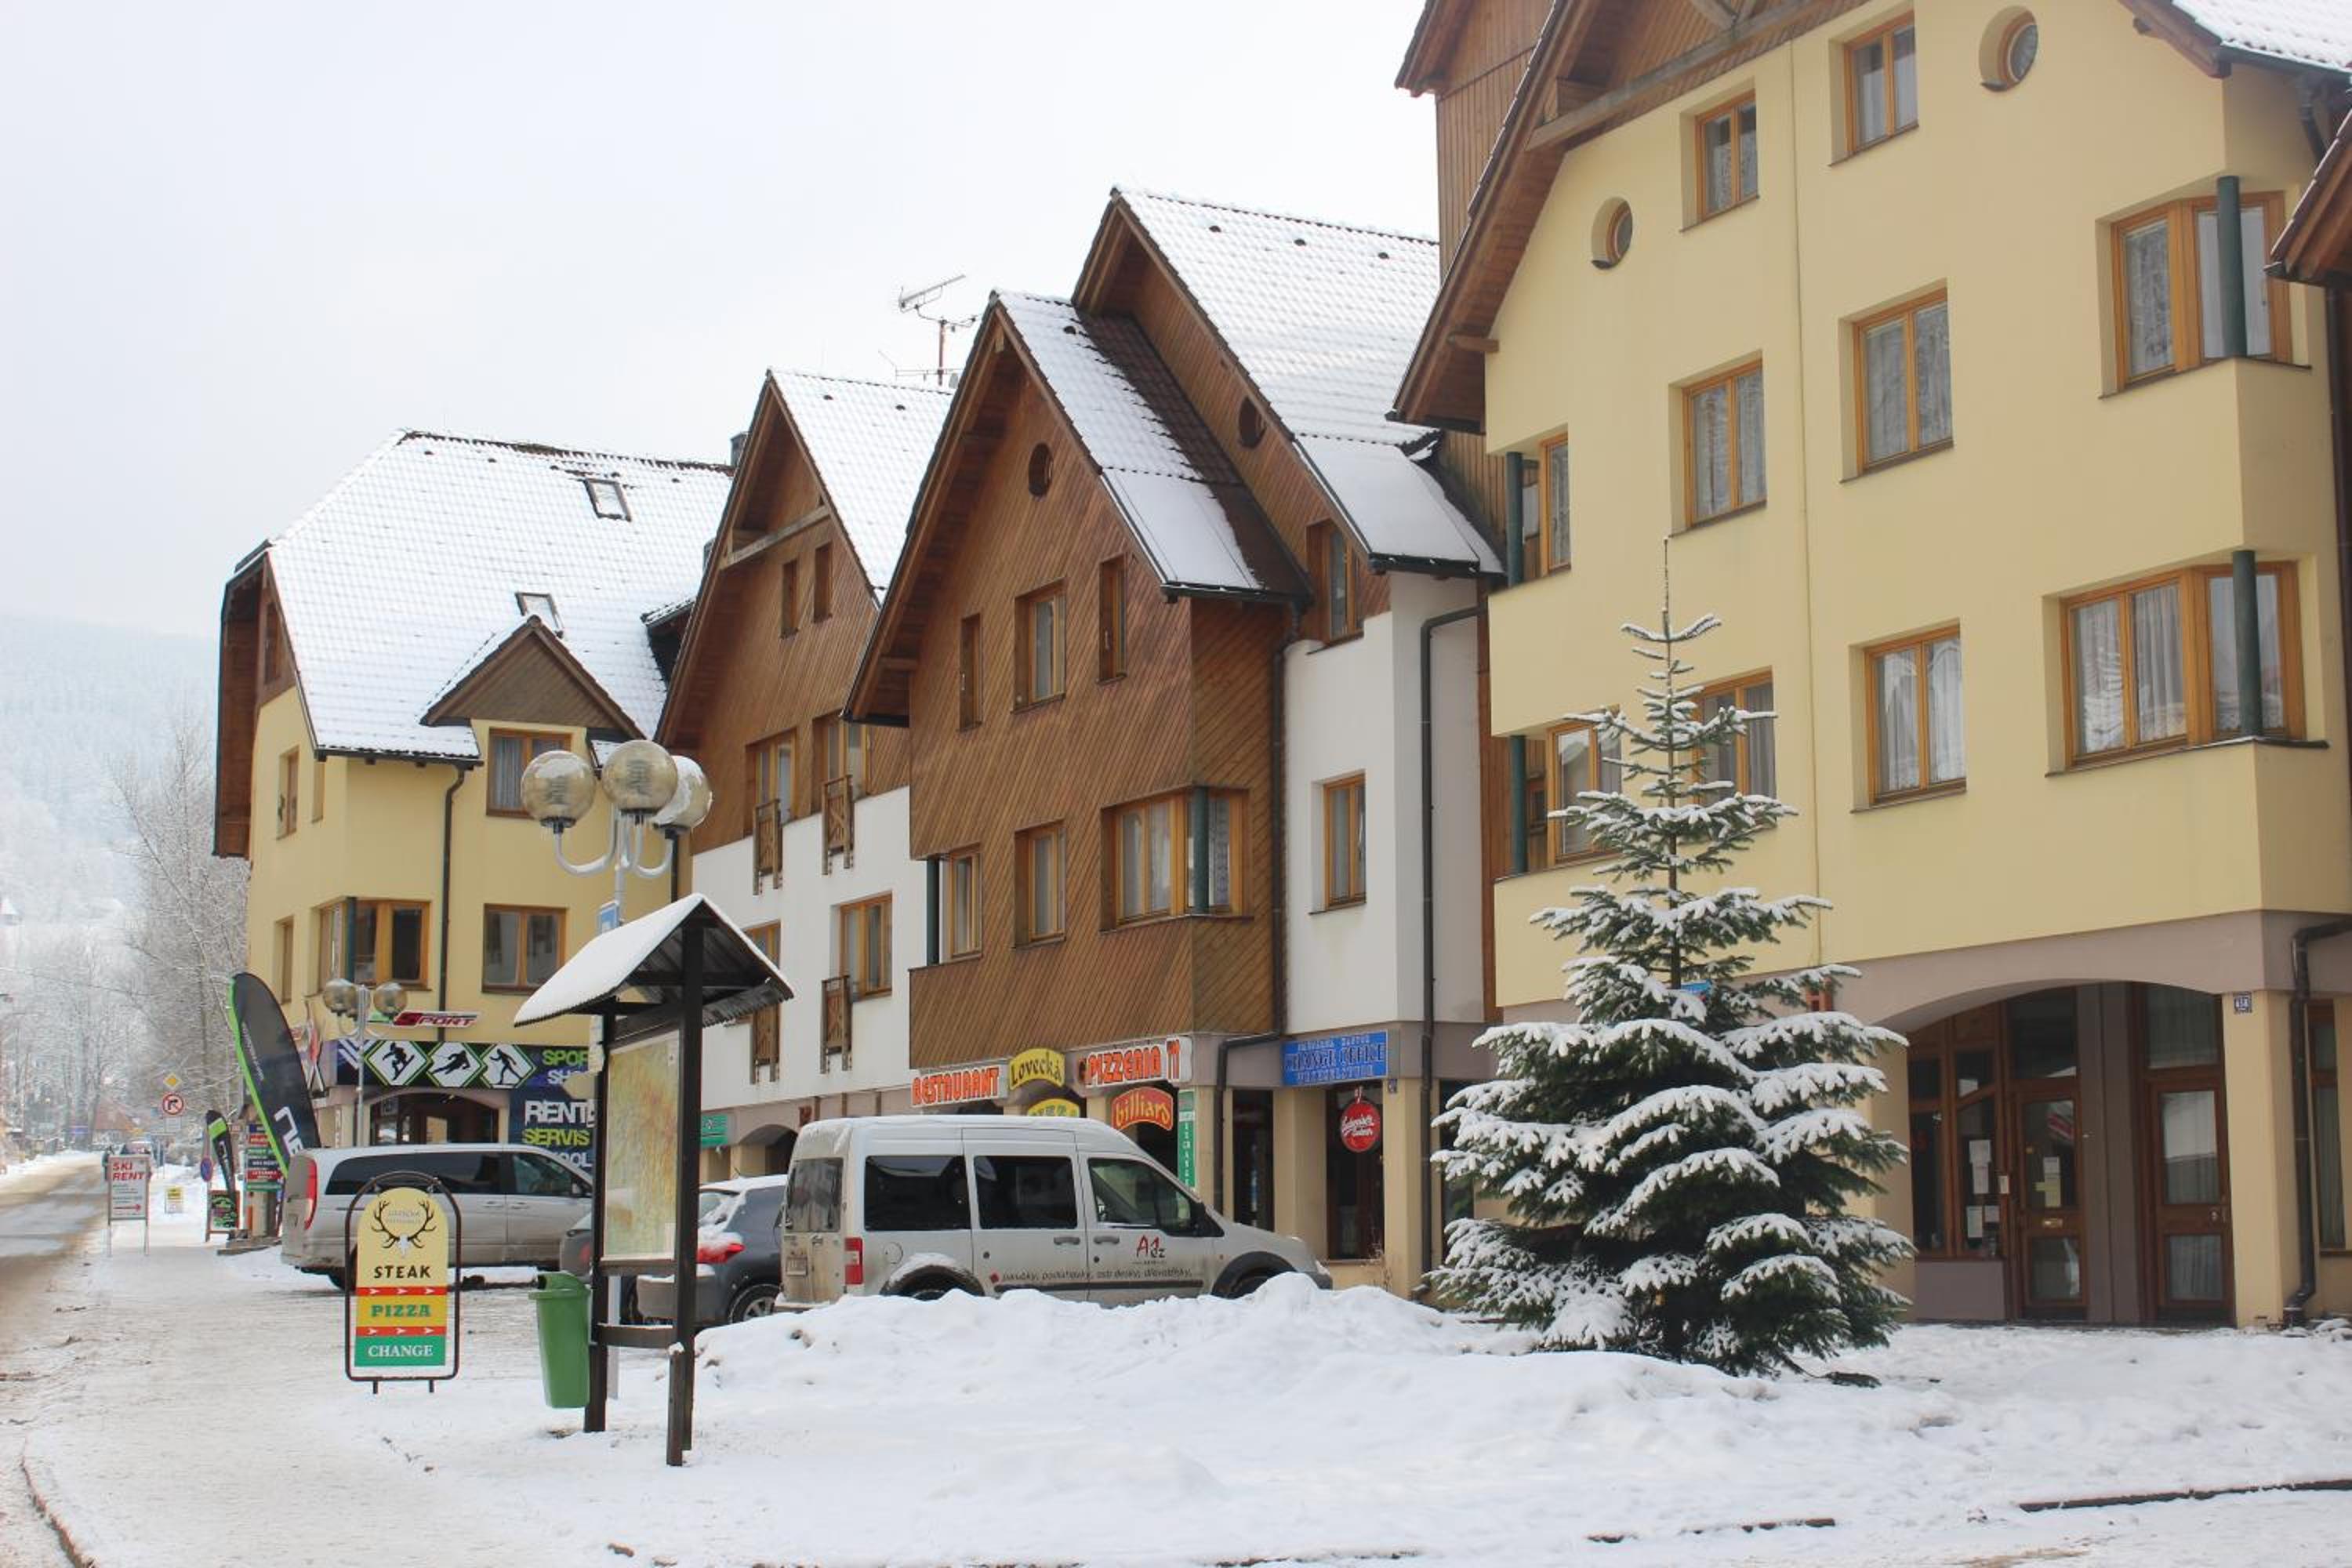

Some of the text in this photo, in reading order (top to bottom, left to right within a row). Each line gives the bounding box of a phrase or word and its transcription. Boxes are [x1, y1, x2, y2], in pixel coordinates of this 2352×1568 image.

[542, 1050, 589, 1066] SPOR
[1086, 1045, 1161, 1085] PIZZERIA
[1011, 1051, 1062, 1086] Lovecká
[912, 1067, 1000, 1105] RESTAURANT
[522, 1128, 590, 1146] SERVIS
[112, 1162, 132, 1171] SKI
[112, 1171, 144, 1181] RENT
[374, 1265, 431, 1278] STEAK
[371, 1304, 431, 1318] PIZZA
[368, 1345, 434, 1358] CHANGE
